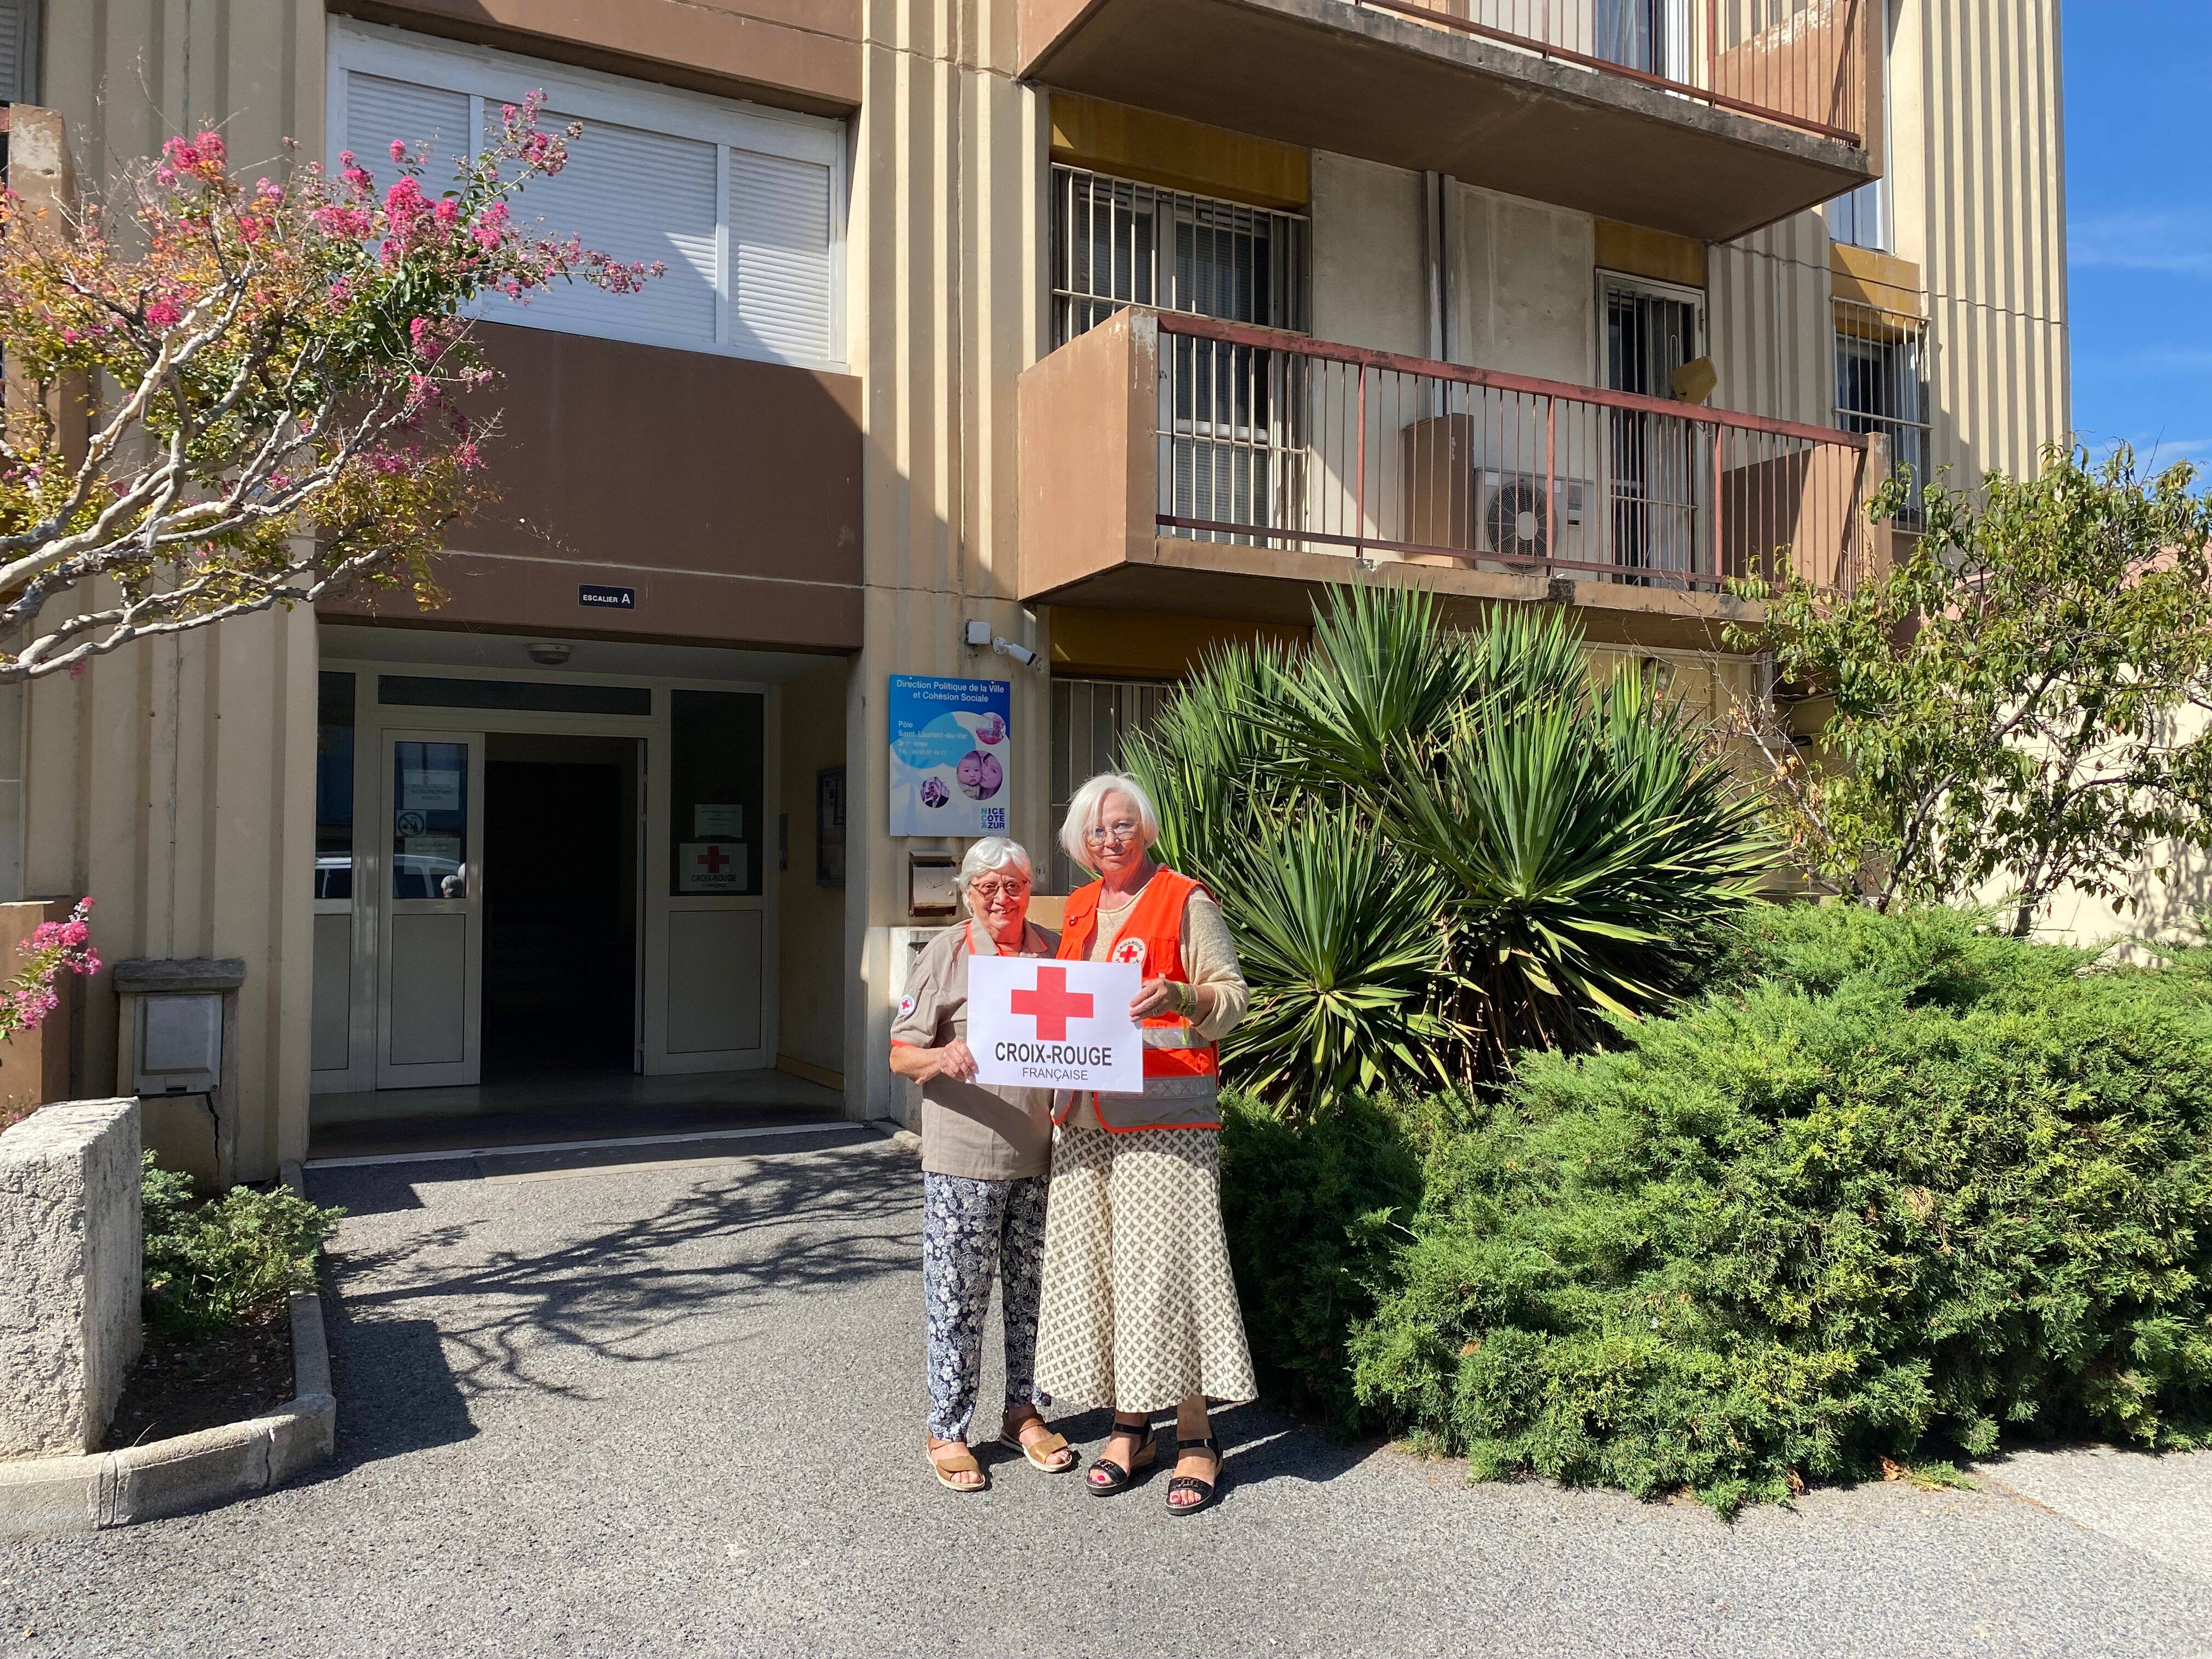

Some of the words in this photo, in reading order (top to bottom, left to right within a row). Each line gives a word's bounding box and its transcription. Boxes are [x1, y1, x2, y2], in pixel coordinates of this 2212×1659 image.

[583, 594, 618, 603] ESCALIER
[622, 593, 631, 603] A
[896, 680, 932, 689] Direction
[934, 682, 967, 692] Politique
[969, 684, 979, 692] de
[980, 684, 987, 692] la
[989, 684, 1005, 693] Ville
[923, 691, 959, 701] Cohésion
[961, 693, 989, 702] Sociale
[691, 874, 737, 882] CROIX-ROUGE
[995, 1041, 1113, 1066] CROIX-ROUGE
[1022, 1067, 1088, 1081] FRANÇAISE
